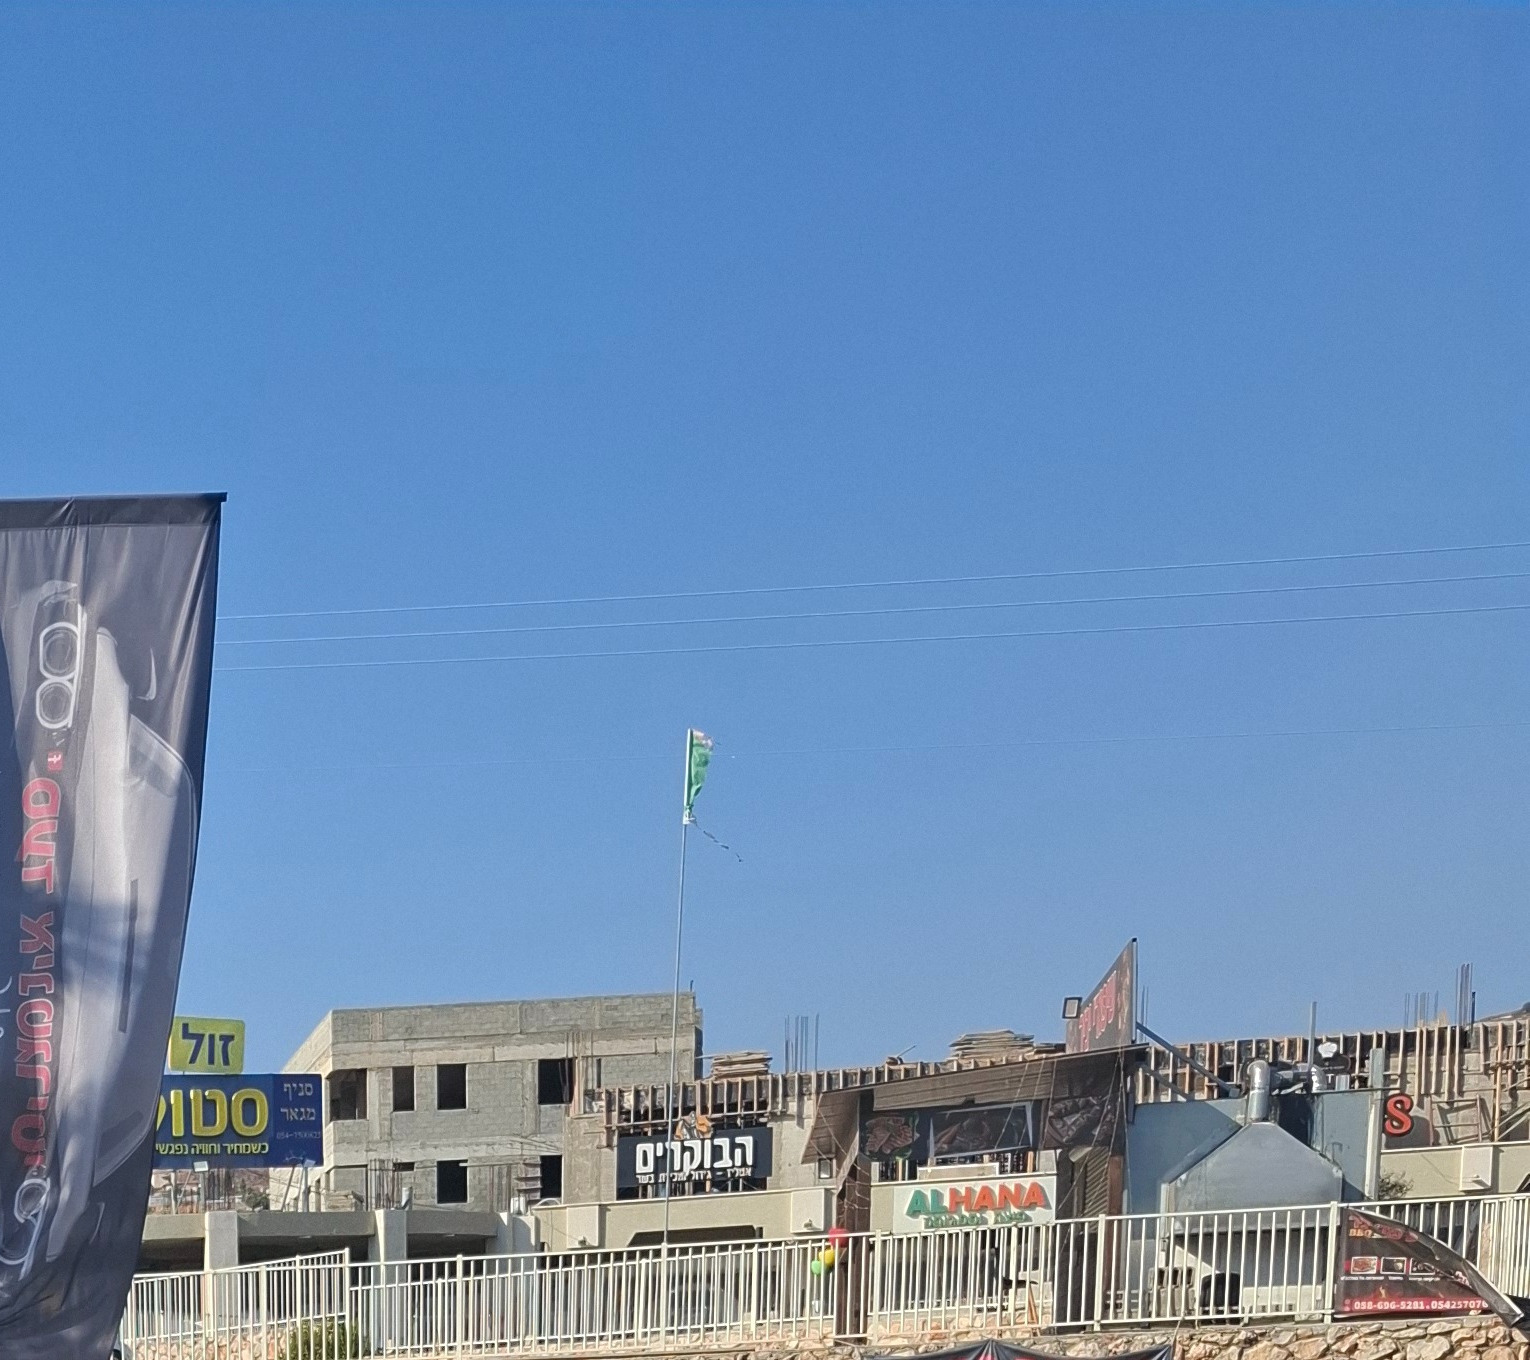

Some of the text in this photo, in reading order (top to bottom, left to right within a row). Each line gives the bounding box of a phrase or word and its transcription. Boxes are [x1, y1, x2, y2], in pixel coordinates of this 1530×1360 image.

[181, 1023, 235, 1066] זול
[283, 1082, 313, 1101] סניף
[156, 1088, 269, 1137] סטו
[280, 1108, 316, 1122] מגאר
[155, 1143, 188, 1155] נפגשי
[222, 1142, 269, 1154] כשמחיר
[636, 1135, 754, 1176] הבוקרים
[905, 1181, 1047, 1216] ALHANA
